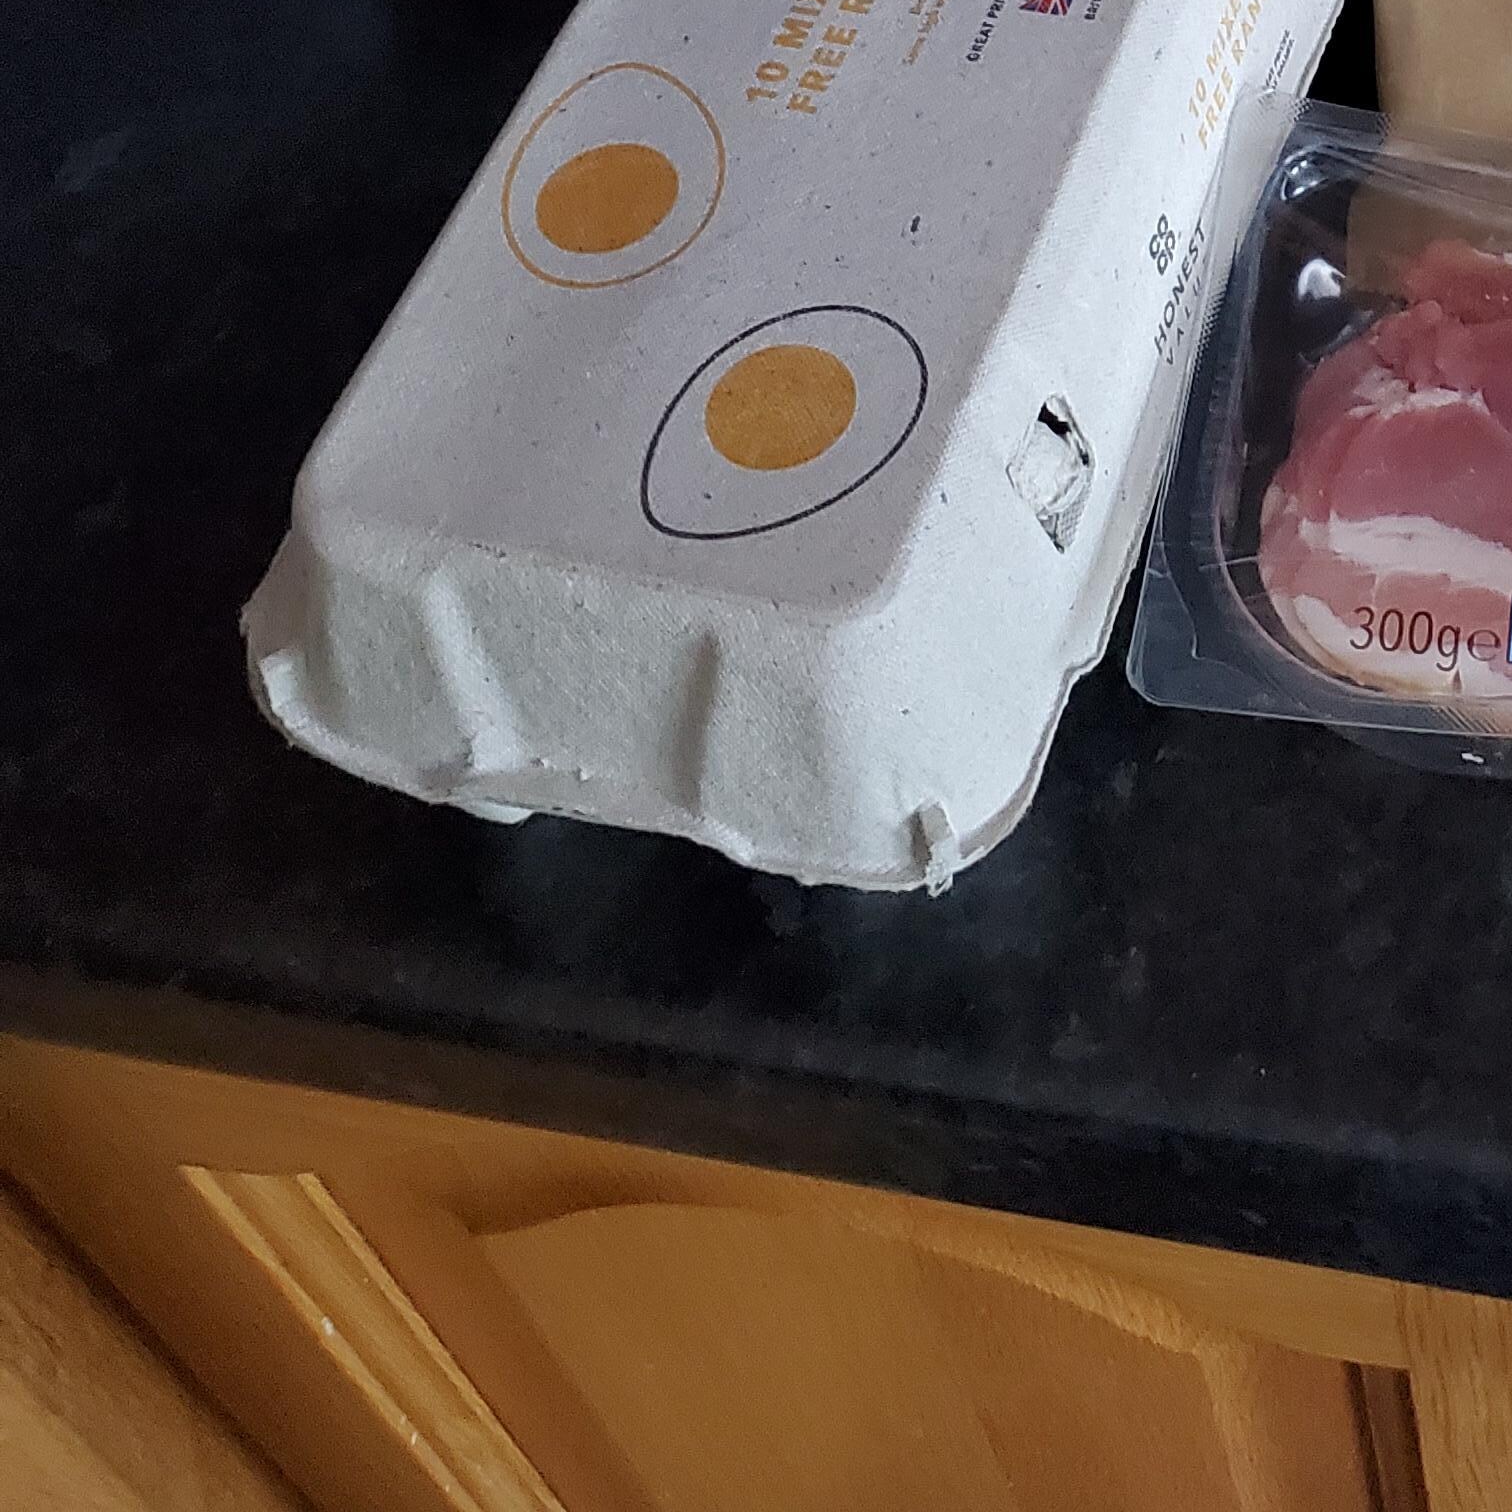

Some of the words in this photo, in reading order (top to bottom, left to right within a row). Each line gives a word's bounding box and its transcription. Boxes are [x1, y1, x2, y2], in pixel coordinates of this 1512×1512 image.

[744, 60, 790, 103] 10
[786, 24, 859, 115] FREE
[966, 20, 995, 62] GREAT
[1188, 76, 1208, 118] 10
[1198, 66, 1233, 150] FREE
[1154, 217, 1205, 356] HONEST
[1166, 268, 1203, 366] VALU
